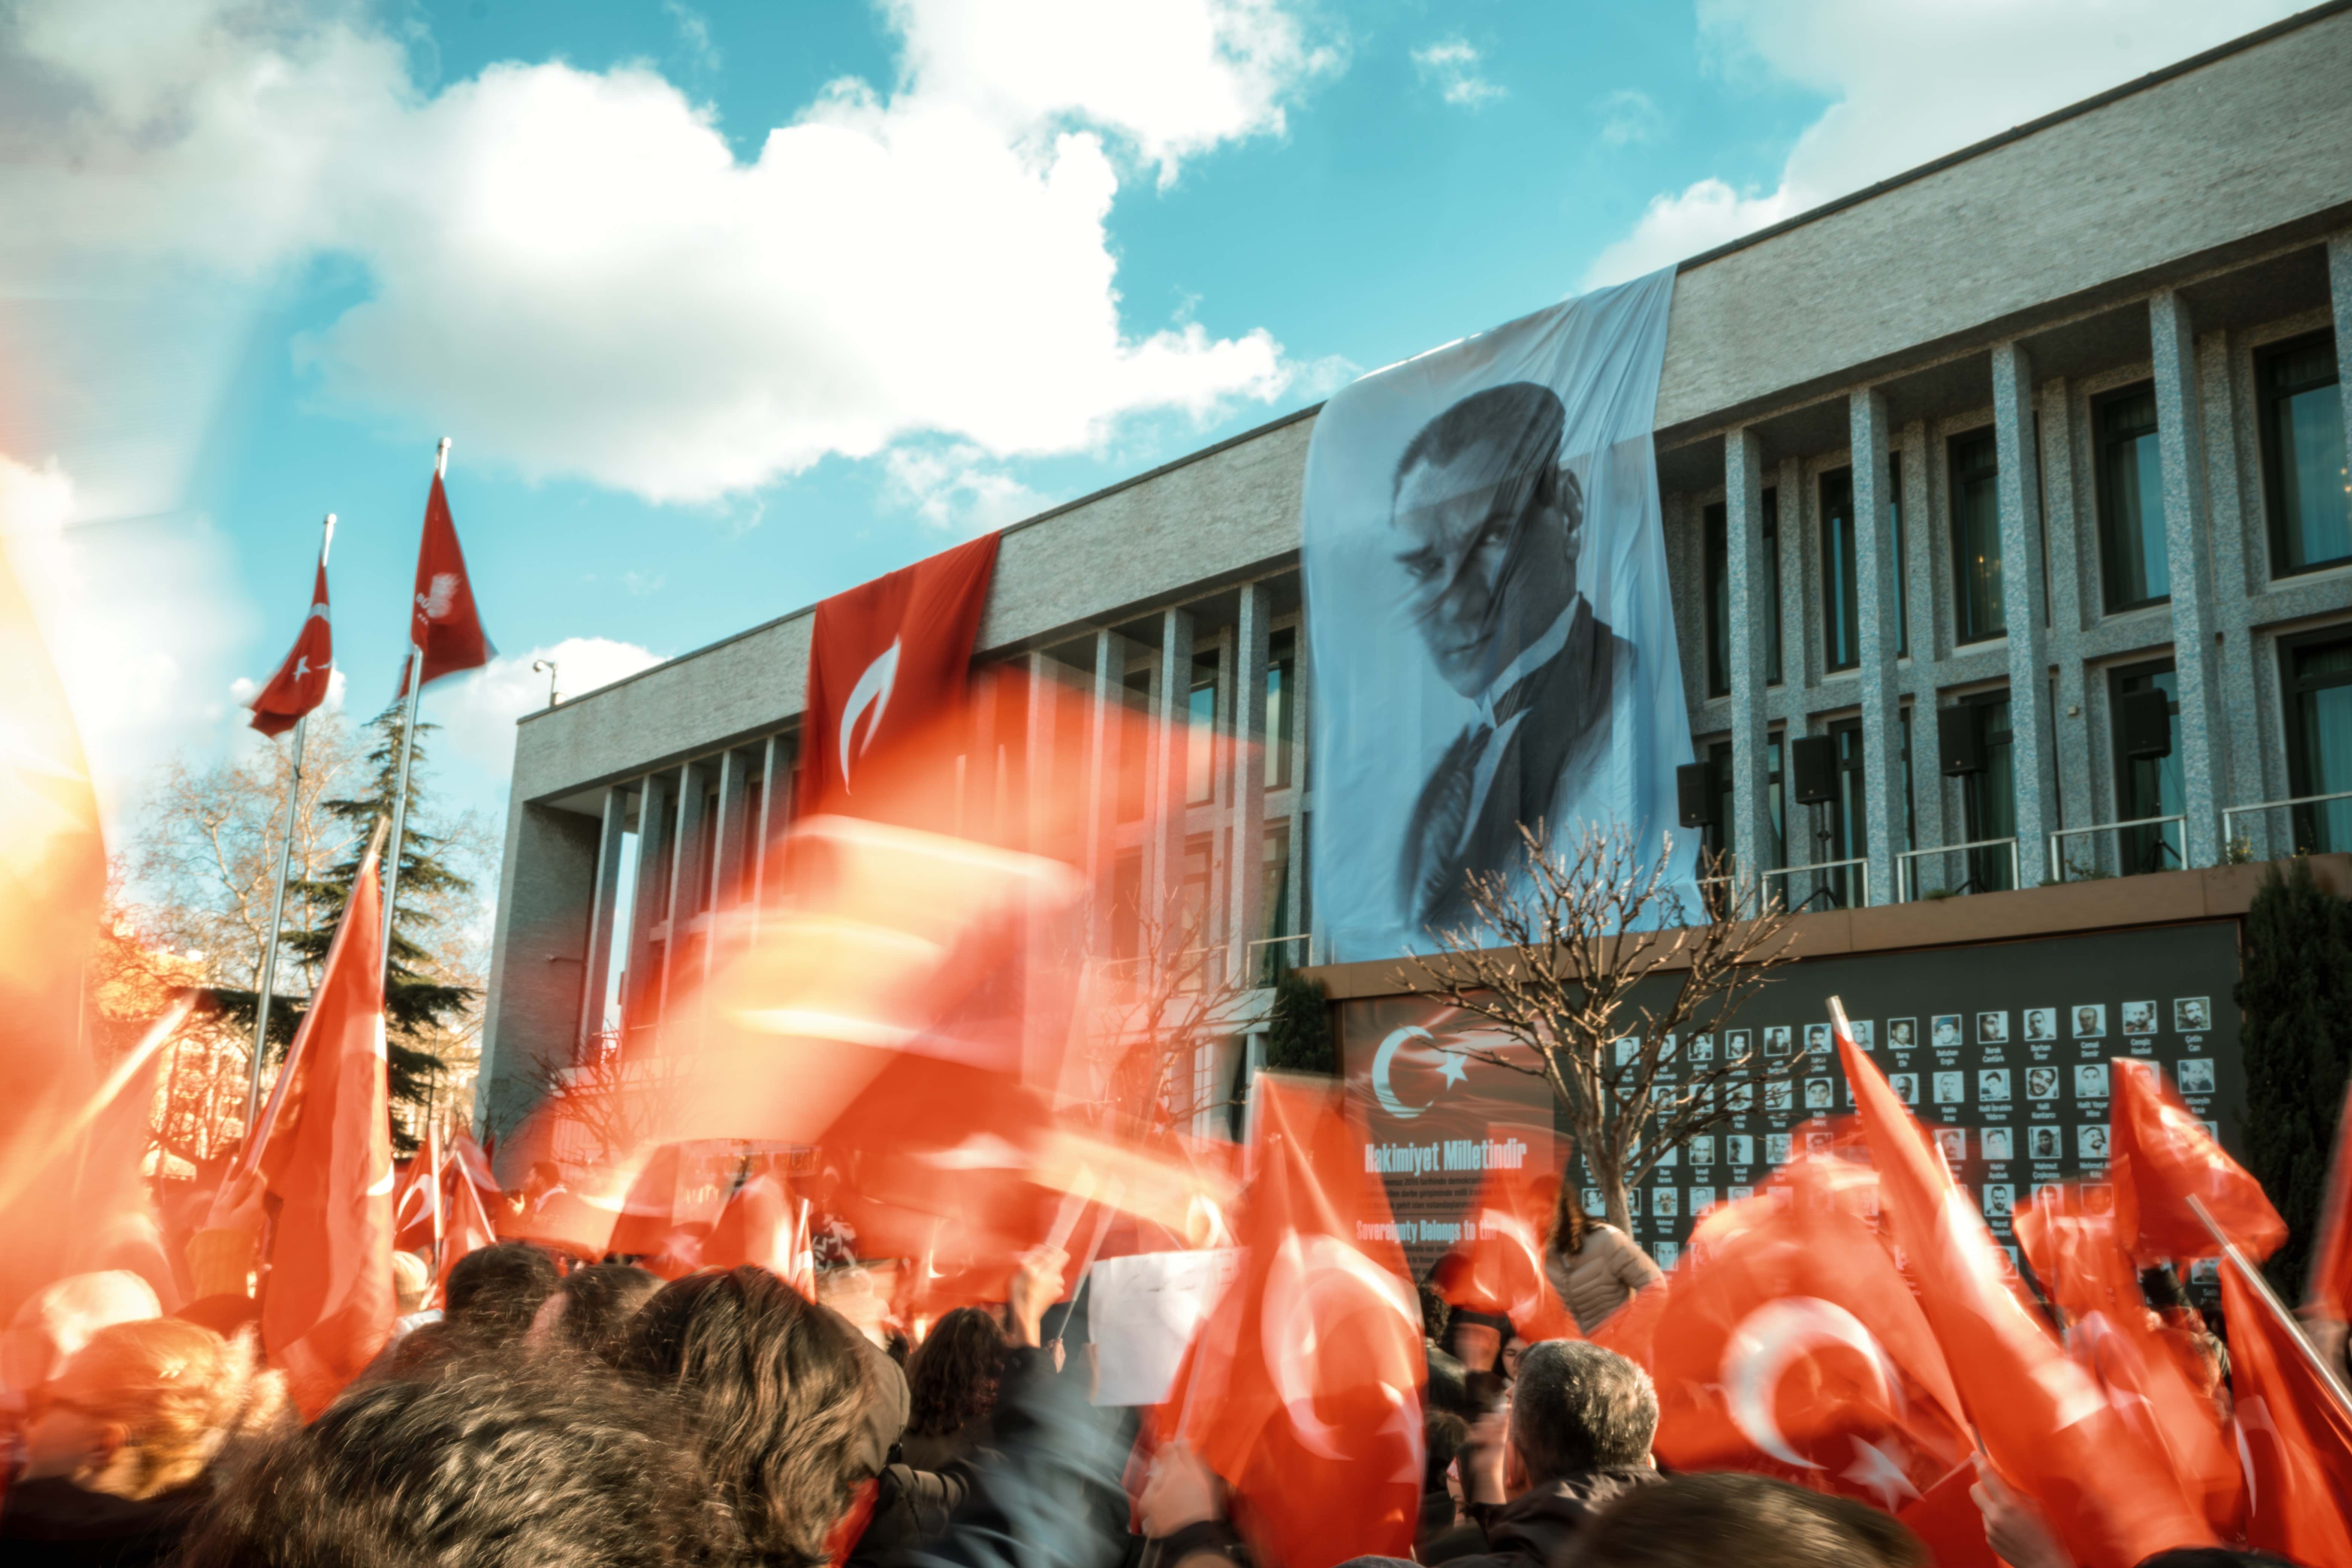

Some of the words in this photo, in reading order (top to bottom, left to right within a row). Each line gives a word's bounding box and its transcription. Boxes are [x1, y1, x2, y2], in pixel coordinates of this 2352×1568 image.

[1365, 1142, 1439, 1176] Hakimiyet
[1444, 1138, 1527, 1171] Milletindir
[1420, 1177, 1447, 1185] tarihinde
[1357, 1219, 1418, 1244] Sovereignty
[1420, 1219, 1461, 1244] Belongs
[1464, 1219, 1476, 1241] to
